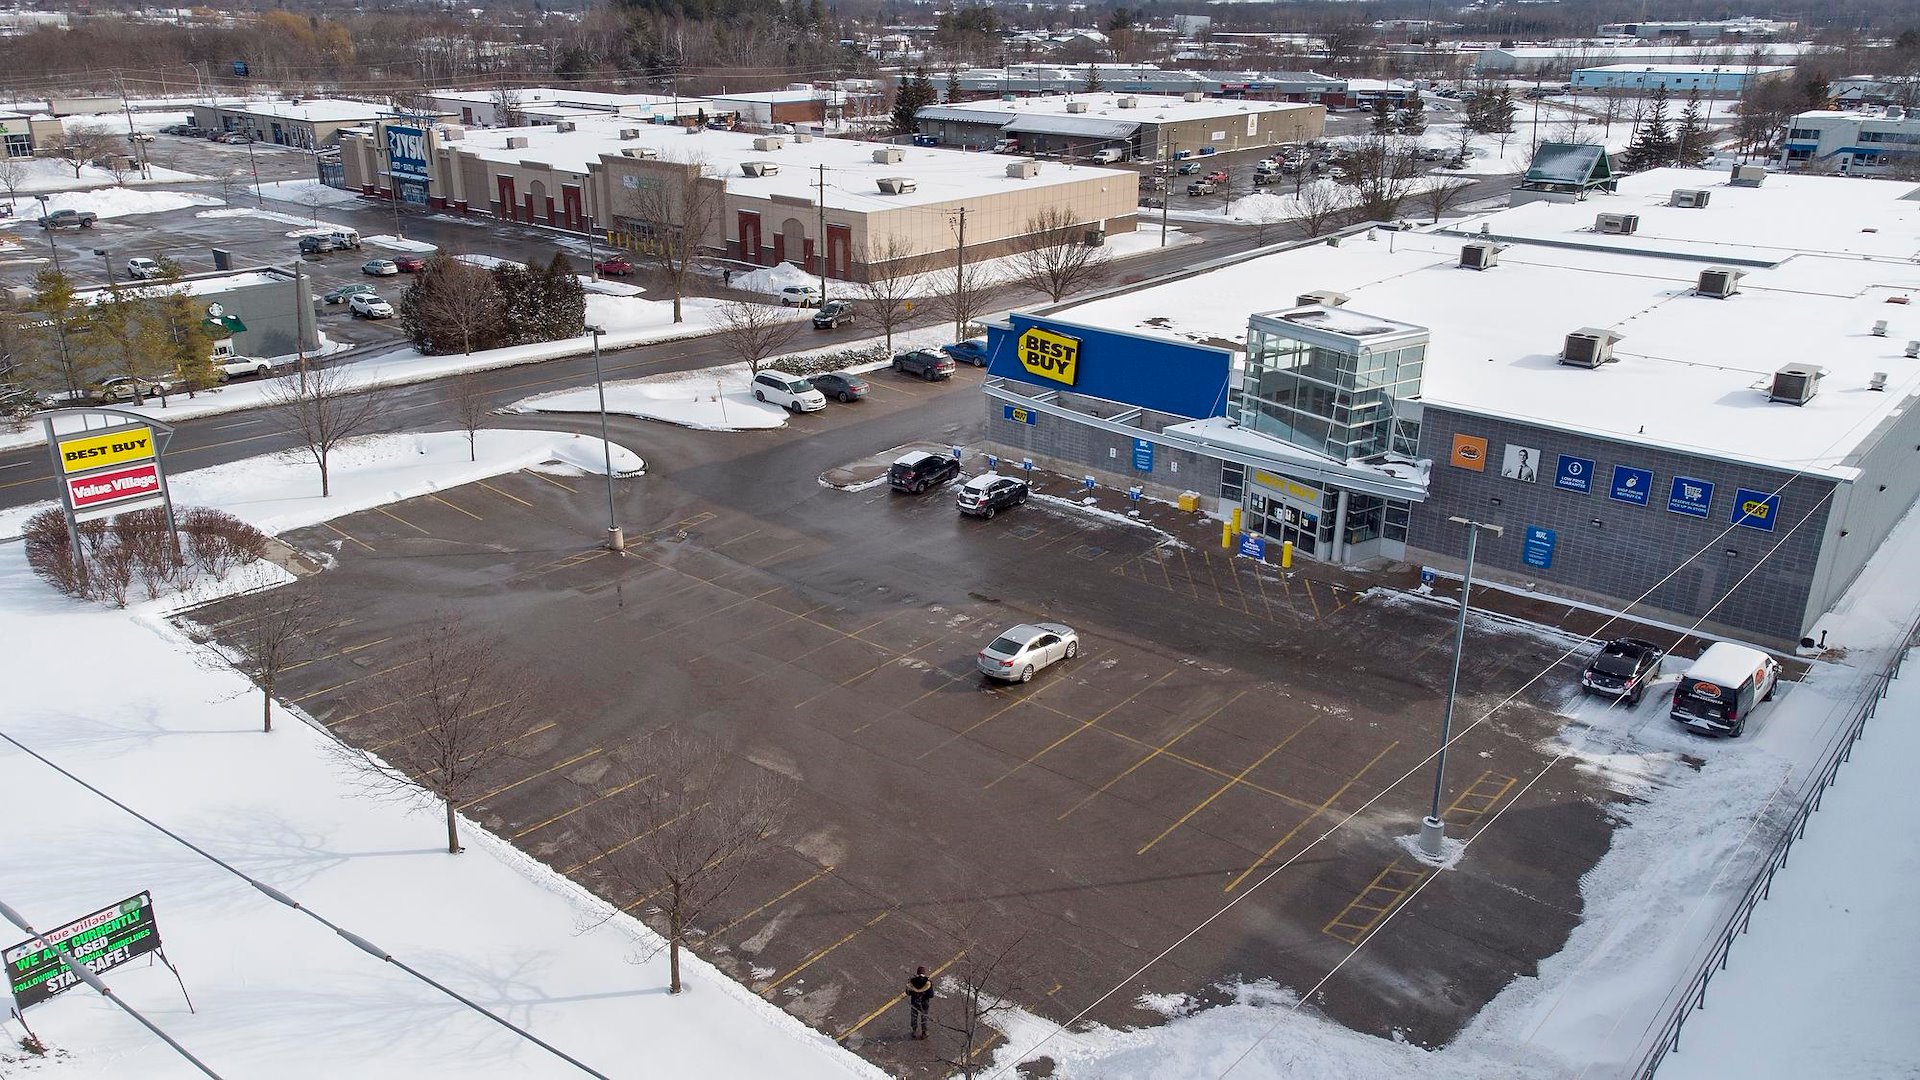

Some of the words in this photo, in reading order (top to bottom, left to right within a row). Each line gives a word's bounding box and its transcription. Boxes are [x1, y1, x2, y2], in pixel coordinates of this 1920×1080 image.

[396, 133, 426, 160] JYSK
[1026, 335, 1076, 362] BEST
[1026, 351, 1070, 375] BUY
[65, 446, 108, 461] BEST
[112, 438, 147, 453] BUY
[73, 483, 112, 498] Value
[111, 474, 157, 491] Village
[15, 953, 40, 972] WE
[71, 909, 141, 948] CURRENTLY
[34, 929, 69, 949] vlue
[72, 911, 114, 934] village
[14, 968, 59, 994] FOLLOWING
[107, 928, 151, 952] GUIDELINES
[59, 936, 109, 965] OSED
[46, 968, 83, 992] STA
[85, 945, 131, 974] SAFE!
